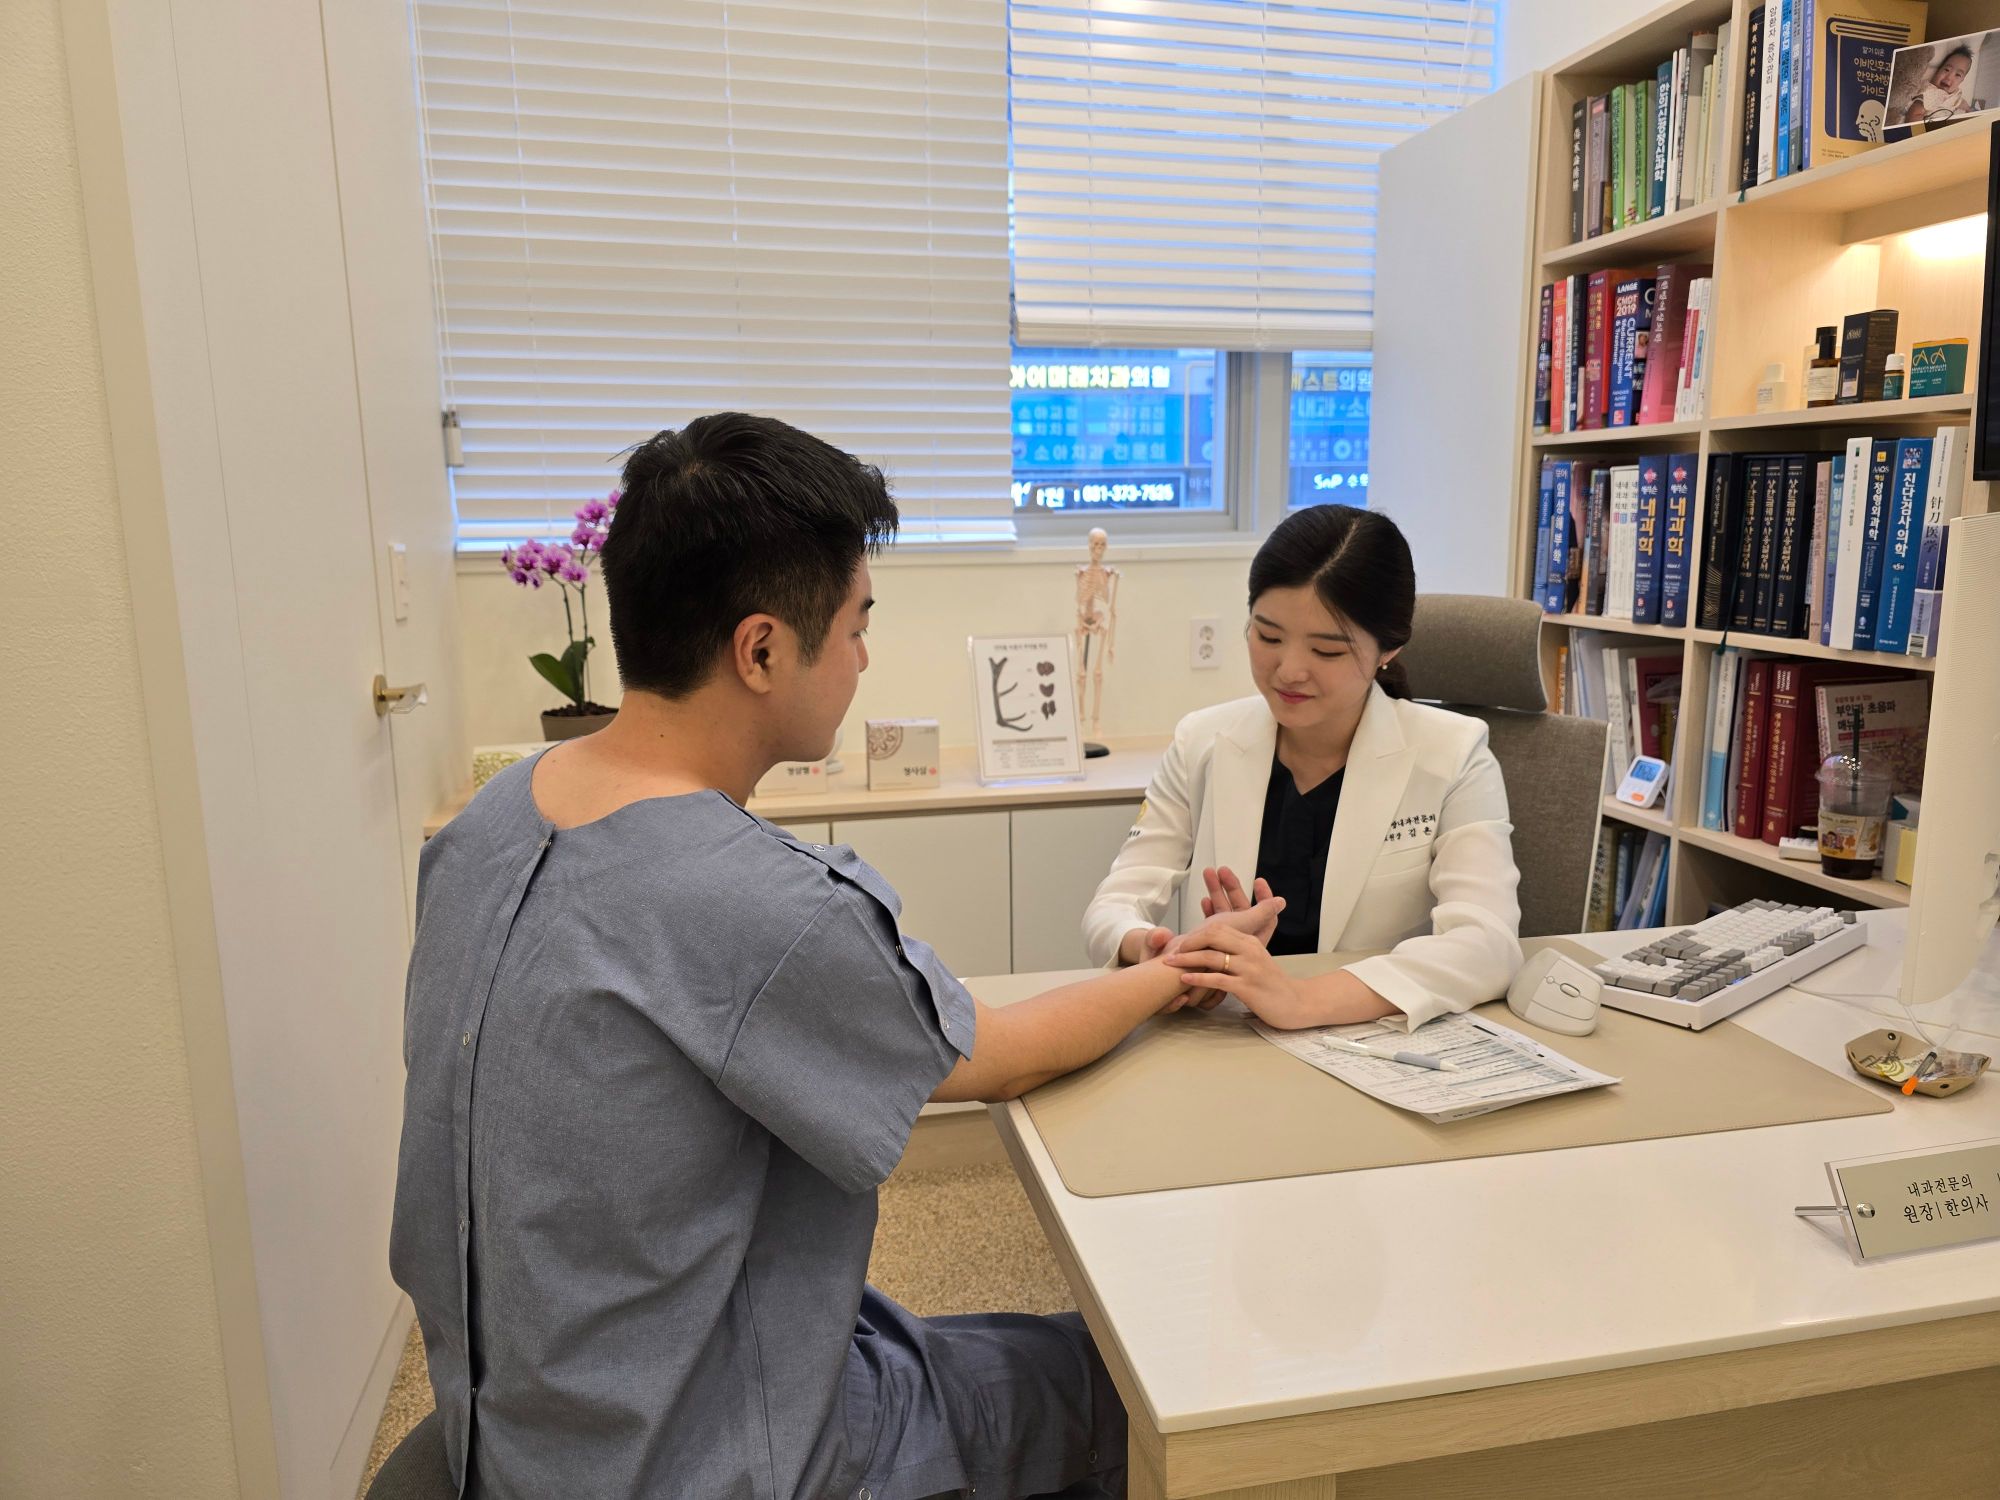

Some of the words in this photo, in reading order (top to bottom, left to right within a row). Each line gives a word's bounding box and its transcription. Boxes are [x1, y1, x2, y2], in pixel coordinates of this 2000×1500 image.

[1861, 85, 1886, 98] 가이드
[1617, 282, 1639, 294] LANGE
[1616, 304, 1637, 317] 2019
[1624, 317, 1635, 379] CURRENT
[1638, 497, 1656, 557] 내과학
[1667, 497, 1687, 557] 내과학
[1868, 482, 1884, 541] 정형외과학
[1895, 473, 1916, 558] 진단검사의학
[1868, 700, 1896, 714] 초음파
[1907, 1174, 1973, 1197] 내과전문의
